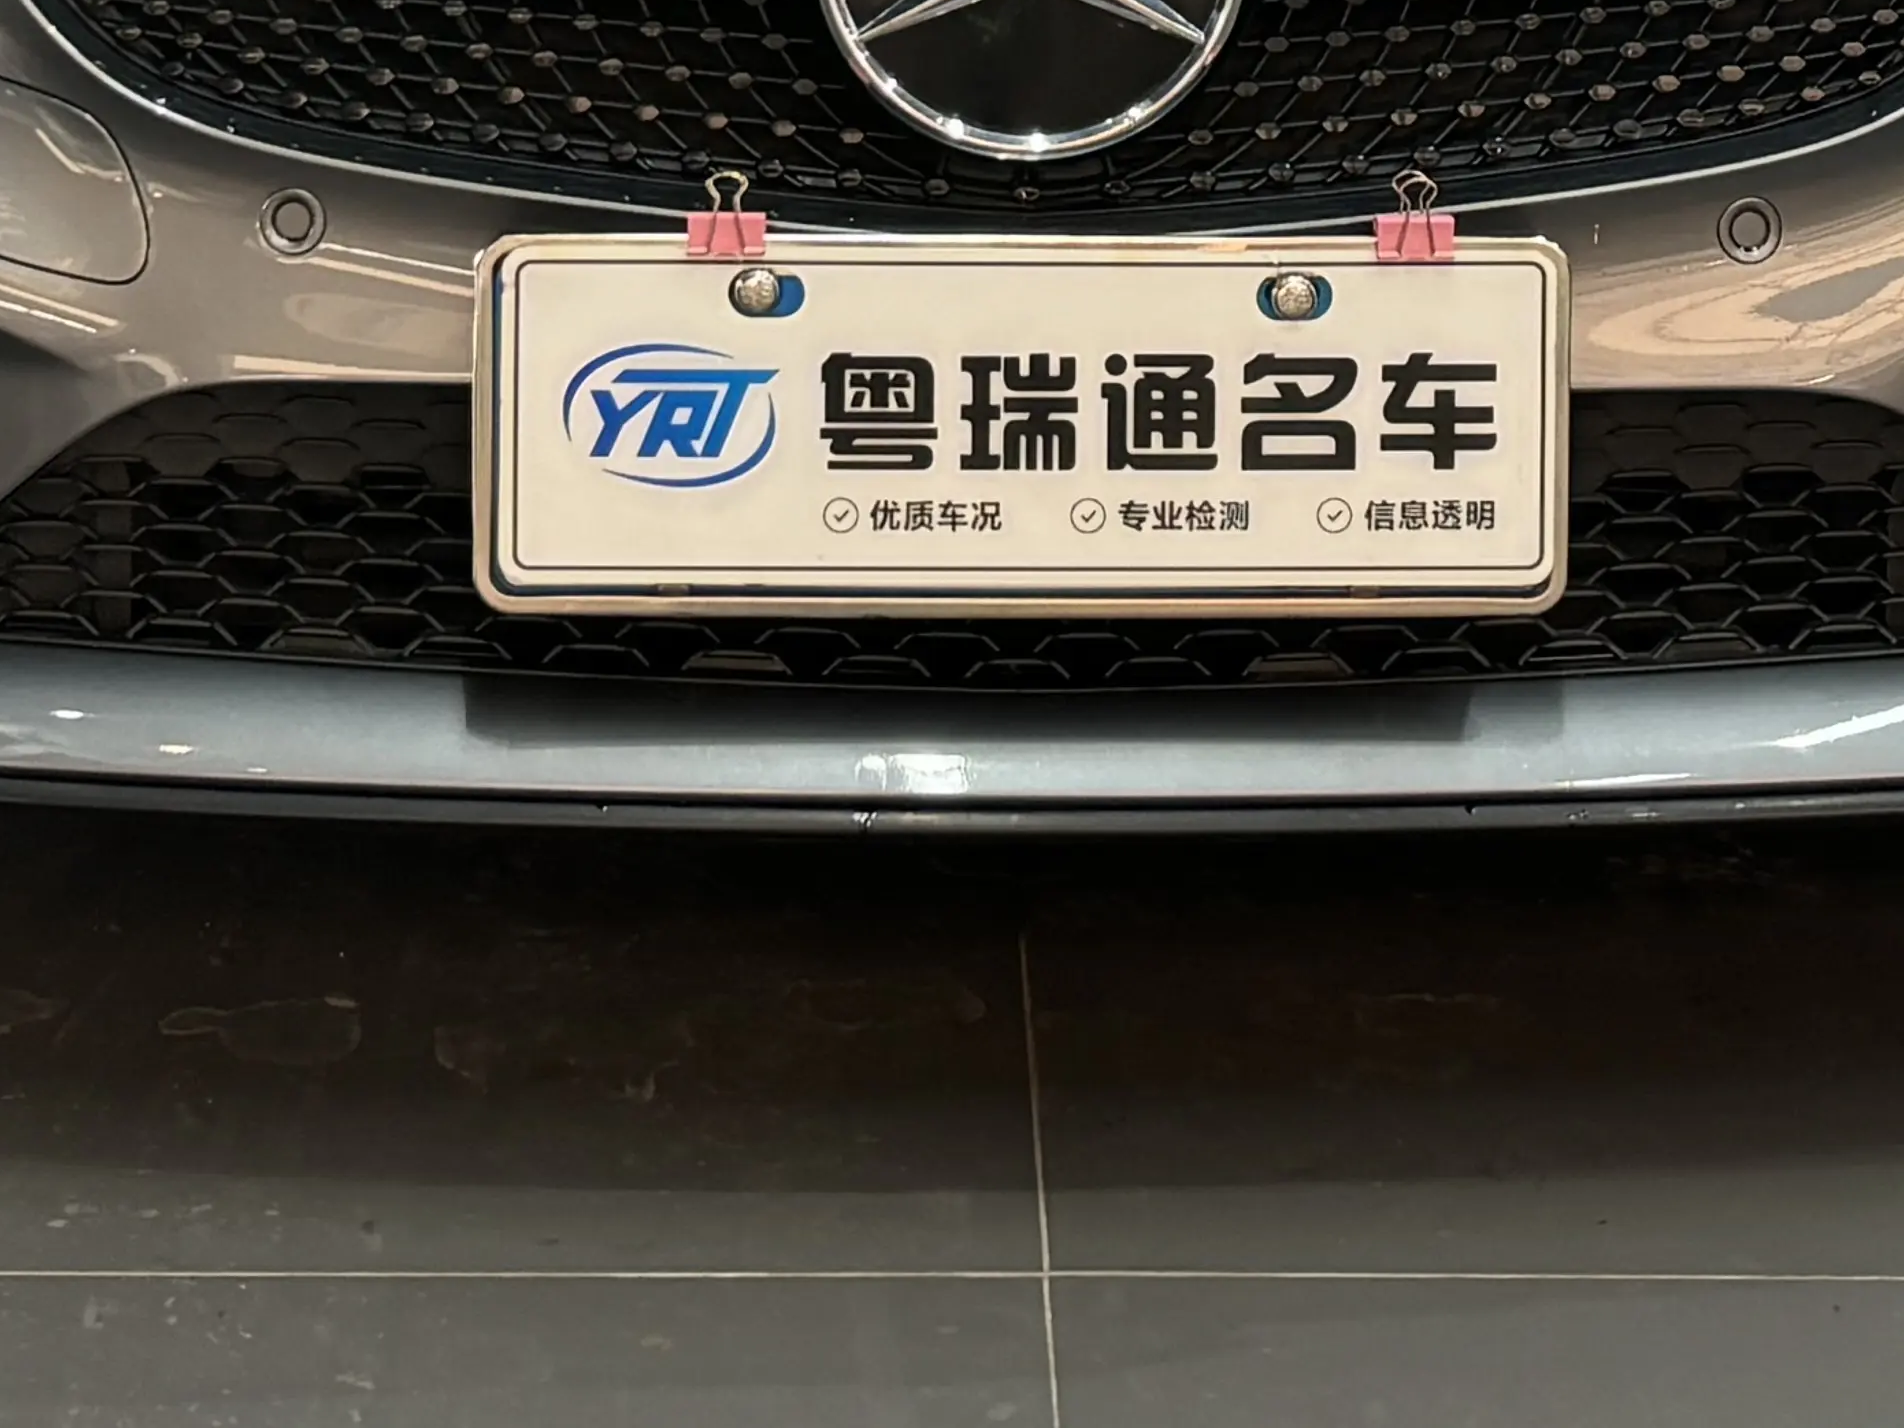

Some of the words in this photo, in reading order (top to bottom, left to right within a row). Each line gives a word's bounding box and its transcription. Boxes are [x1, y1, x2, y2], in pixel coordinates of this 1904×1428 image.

[588, 368, 781, 458] YRT
[819, 351, 1498, 471] 粤瑞通名车
[869, 498, 1003, 533] 优质车况
[1117, 498, 1251, 533] 专业检测
[1363, 498, 1498, 533] 信息透明
